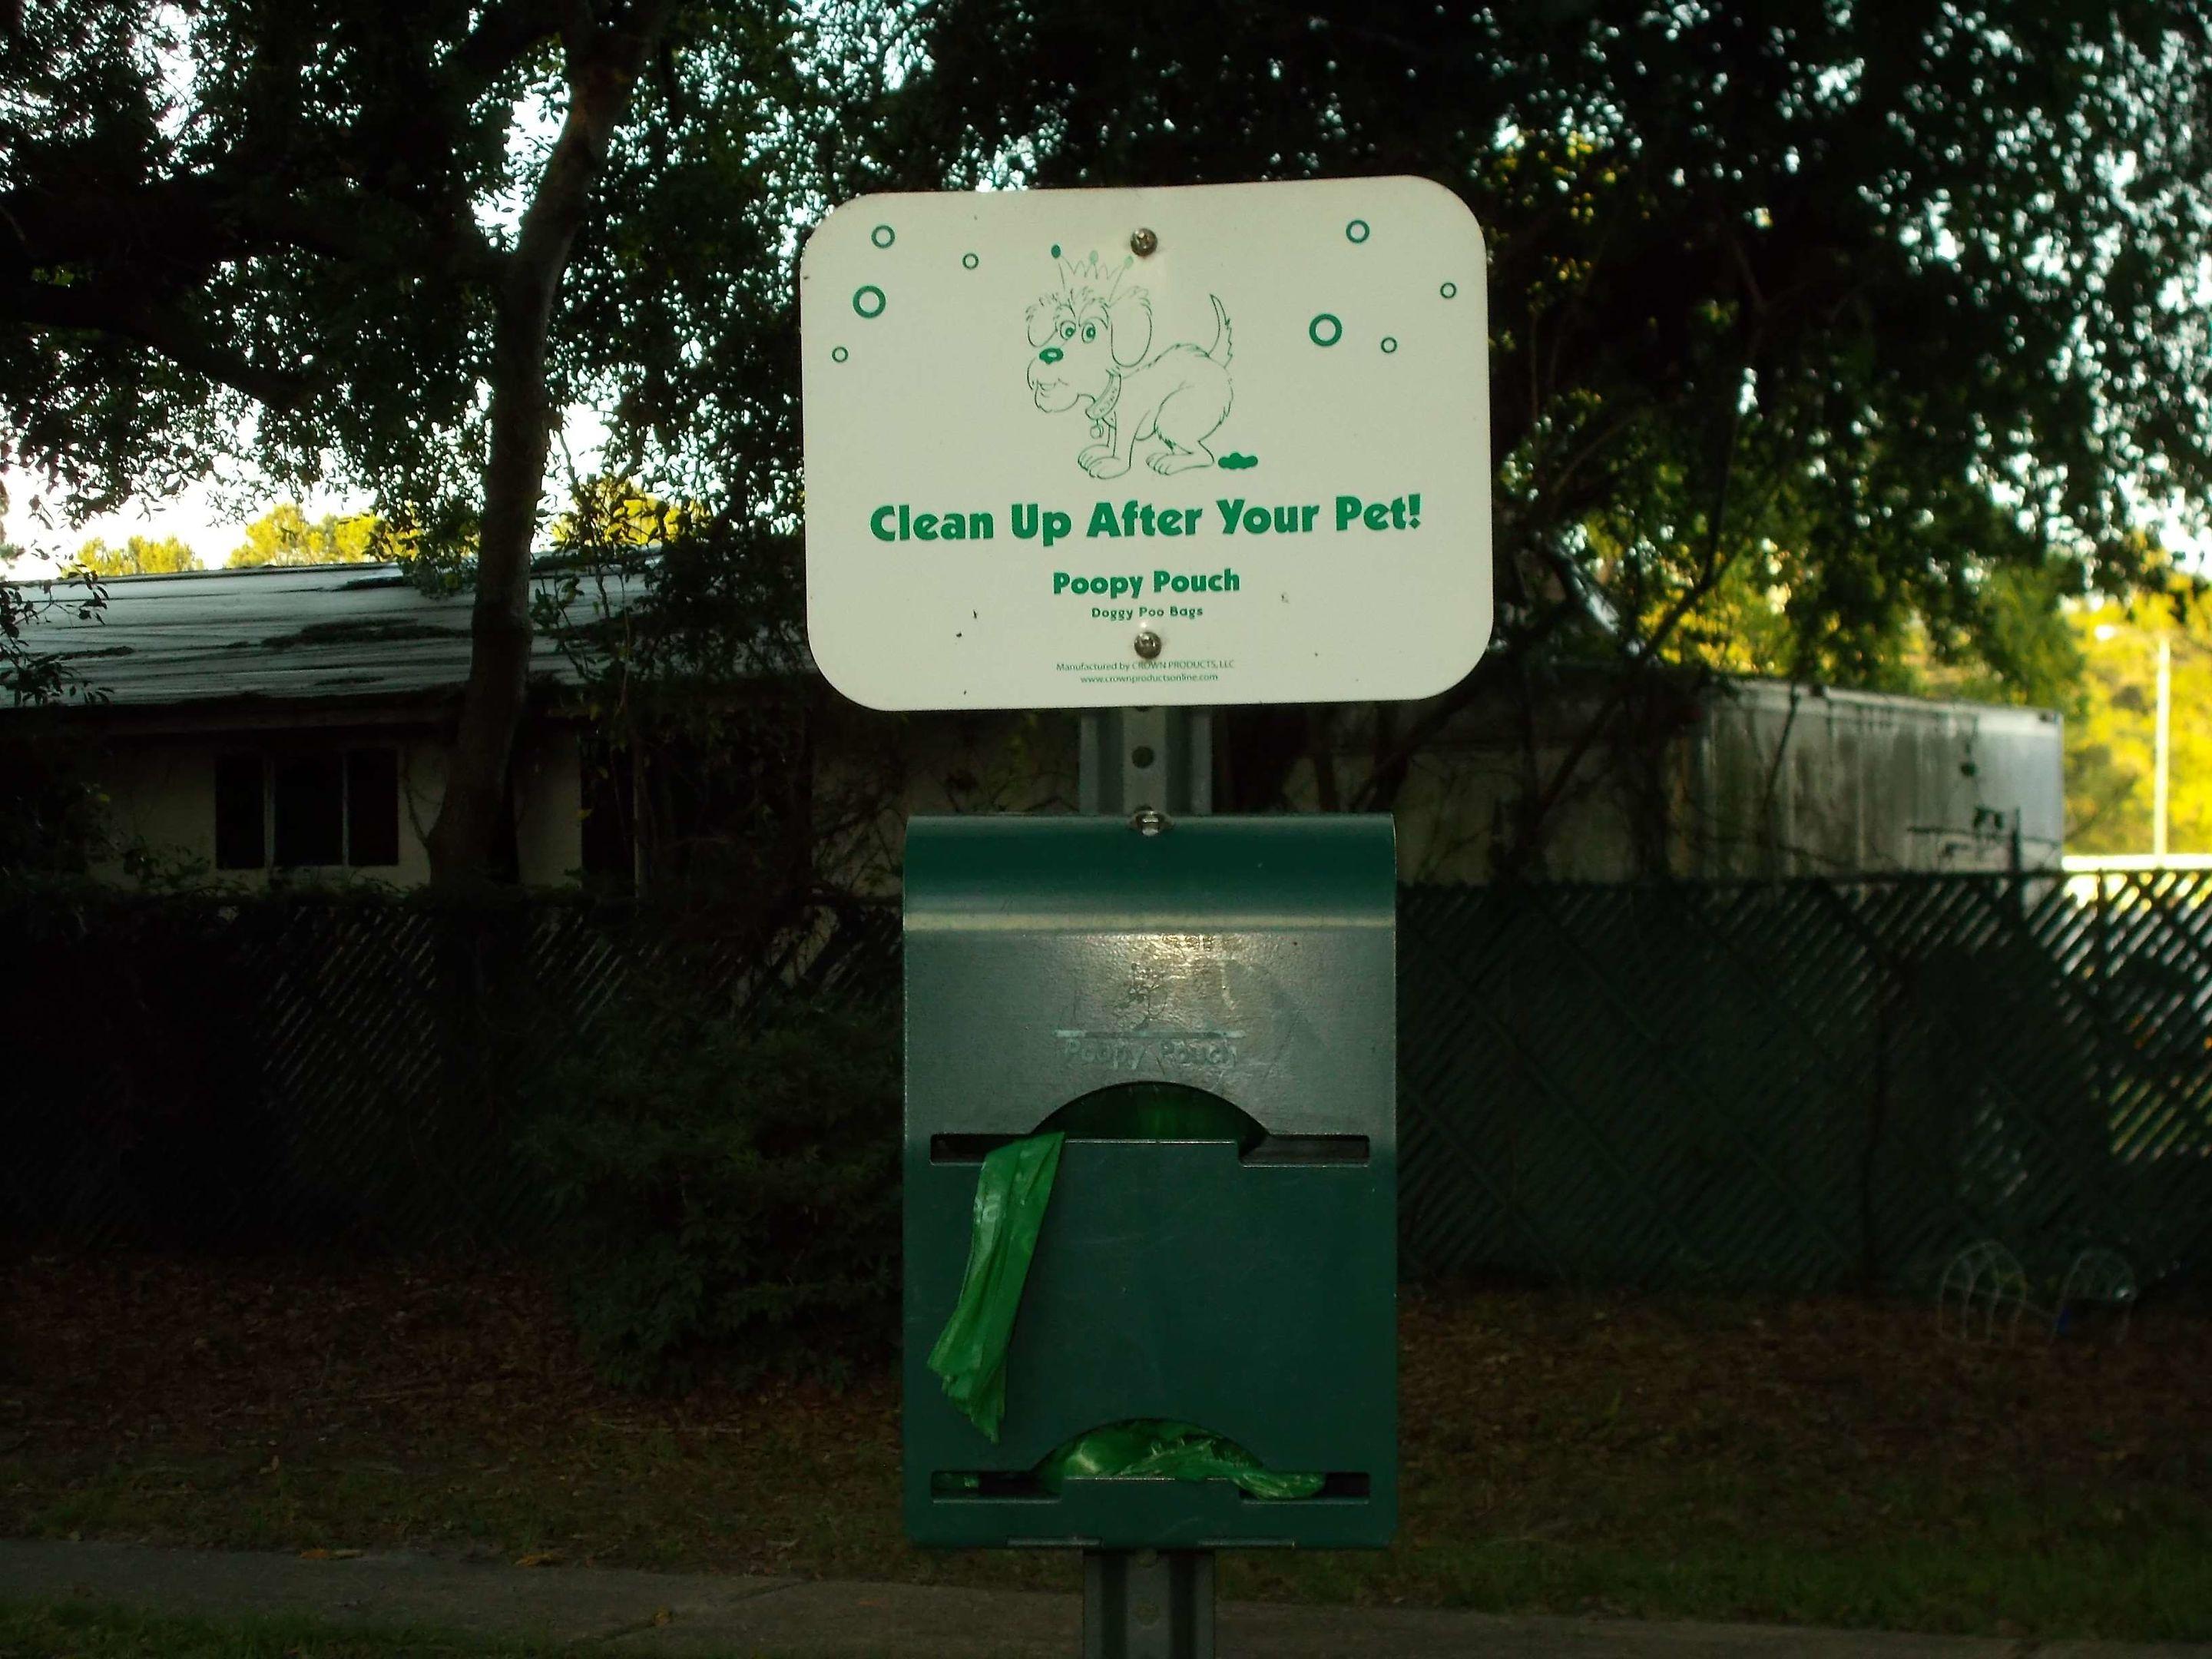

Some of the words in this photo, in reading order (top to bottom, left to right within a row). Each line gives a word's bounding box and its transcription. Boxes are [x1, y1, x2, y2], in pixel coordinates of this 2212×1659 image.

[870, 504, 994, 542] Clean
[1011, 502, 1071, 548] Up
[1086, 499, 1203, 538] After
[1216, 498, 1320, 535] Your
[1336, 493, 1421, 532] Pet!
[1053, 571, 1144, 599] Poopy
[1154, 568, 1240, 593] Pouch
[1092, 608, 1133, 621] Doggy
[1139, 606, 1164, 618] Poo
[1170, 605, 1203, 620] Bags
[1057, 662, 1117, 671] Manufactured
[1120, 662, 1130, 671] by
[1132, 661, 1166, 669] CROWN
[1168, 661, 1218, 671] PRODUCTS,
[1220, 660, 1233, 668] LLC
[1081, 674, 1218, 684] www.crownproductsonline.com
